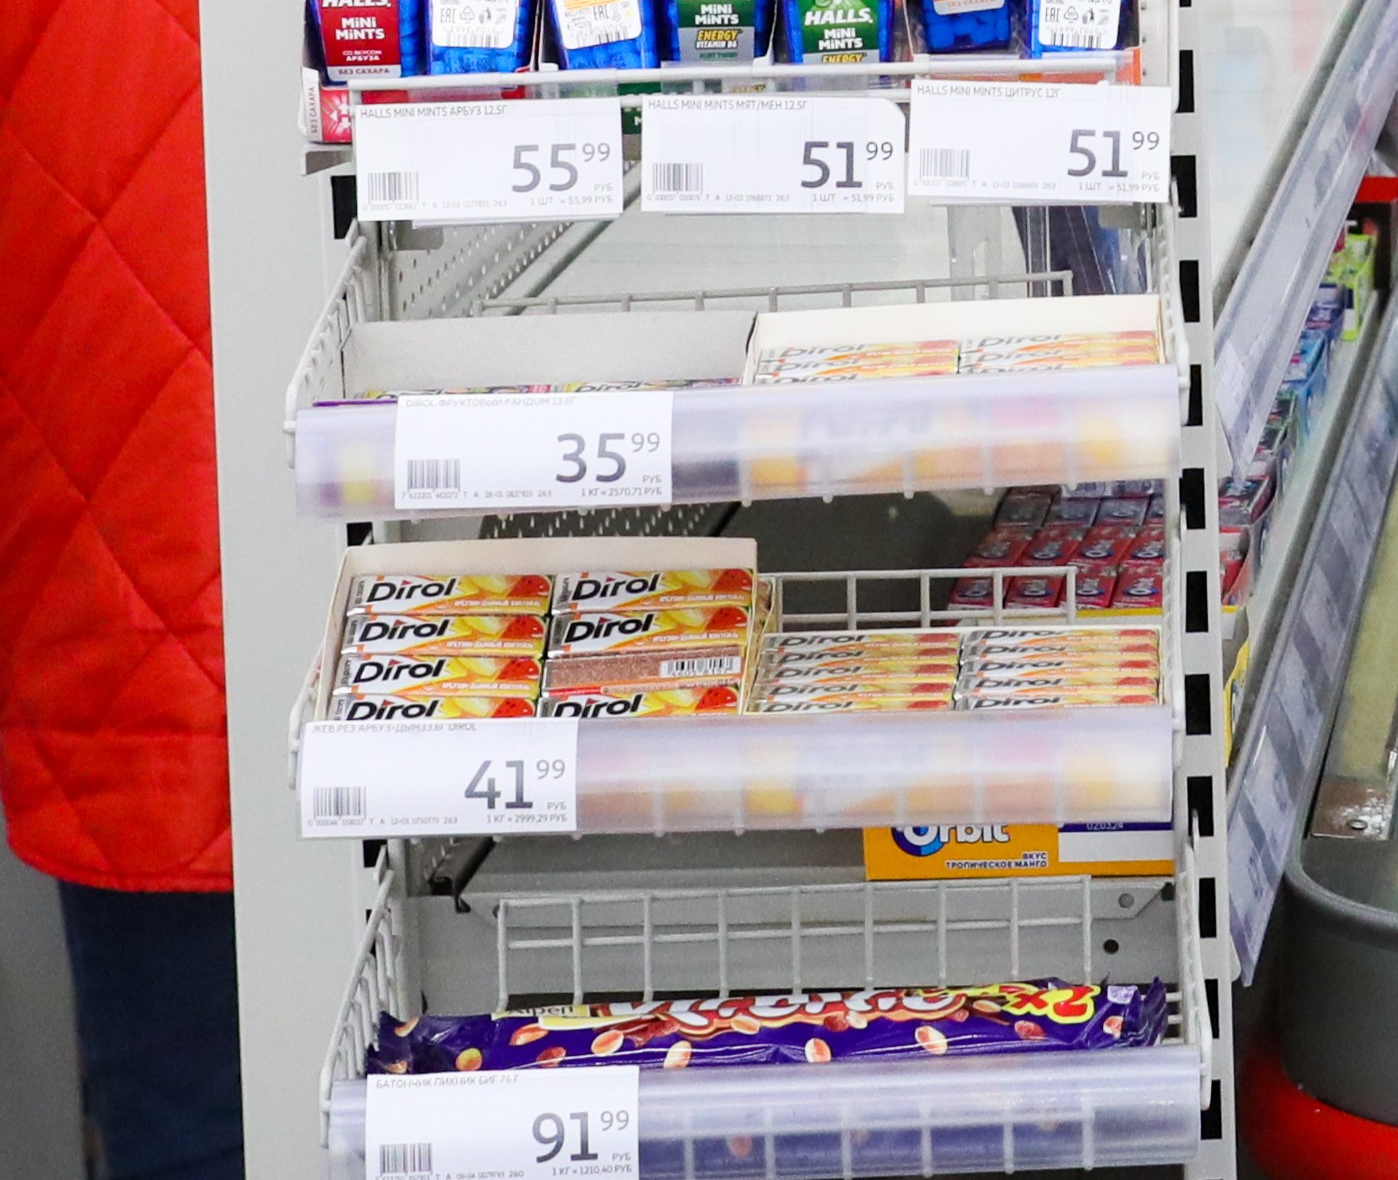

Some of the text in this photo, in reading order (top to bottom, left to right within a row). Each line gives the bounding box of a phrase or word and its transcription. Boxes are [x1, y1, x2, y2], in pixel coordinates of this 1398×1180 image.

[805, 8, 873, 25] HALLS
[697, 30, 739, 41] ENERGY
[917, 86, 948, 95] HALLS
[950, 86, 971, 96] MINI
[973, 87, 1003, 97] MINTS
[1006, 87, 1043, 98] ЦИТРУС
[648, 100, 679, 109] HALLS
[681, 100, 702, 109] MINI
[704, 100, 734, 109] MINTS
[736, 100, 782, 110] МЯТ/МЕН
[360, 108, 391, 119] HALLS
[394, 107, 416, 117] MINI
[417, 107, 447, 117] MINTS
[450, 106, 481, 116] АРБУЗ
[1067, 129, 1160, 177] 51 99
[512, 143, 610, 192] 55 99
[801, 141, 893, 188] 51 99
[1142, 172, 1160, 180] РУБ
[594, 183, 613, 192] РУБ
[876, 181, 894, 190] РУБ
[1141, 184, 1160, 192] РУБ
[594, 195, 613, 204] РУБ
[876, 193, 894, 201] РУБ
[978, 334, 1061, 347] Dirol
[781, 344, 865, 357] Dirol
[555, 433, 660, 483] 35 99
[642, 475, 662, 483] РУБ
[644, 486, 662, 495] РУБ
[367, 578, 456, 602] Dirol
[571, 574, 661, 601] Dirol
[359, 620, 449, 642] Dirol
[564, 614, 654, 643] Dirol
[779, 635, 866, 646] Dirol
[776, 650, 863, 664] Dirol
[353, 660, 446, 683] Dirol
[774, 666, 862, 679] Dirol
[976, 678, 1063, 688] Dirol
[768, 684, 858, 695] Dirol
[554, 694, 644, 717] Dirol
[763, 701, 854, 712] Dirol
[974, 696, 1060, 708] Dirol
[347, 700, 440, 720] Dirol
[464, 759, 566, 810] 41 99
[547, 802, 566, 810] РУБ
[550, 814, 567, 822] РУБ
[1022, 852, 1047, 860] ВКУС
[946, 860, 1047, 869] ТРОПИЧЕСКОЕ МАНГО
[532, 1110, 629, 1163] 91 99
[613, 1153, 631, 1161] РУБ
[614, 1164, 632, 1173] РУБ
